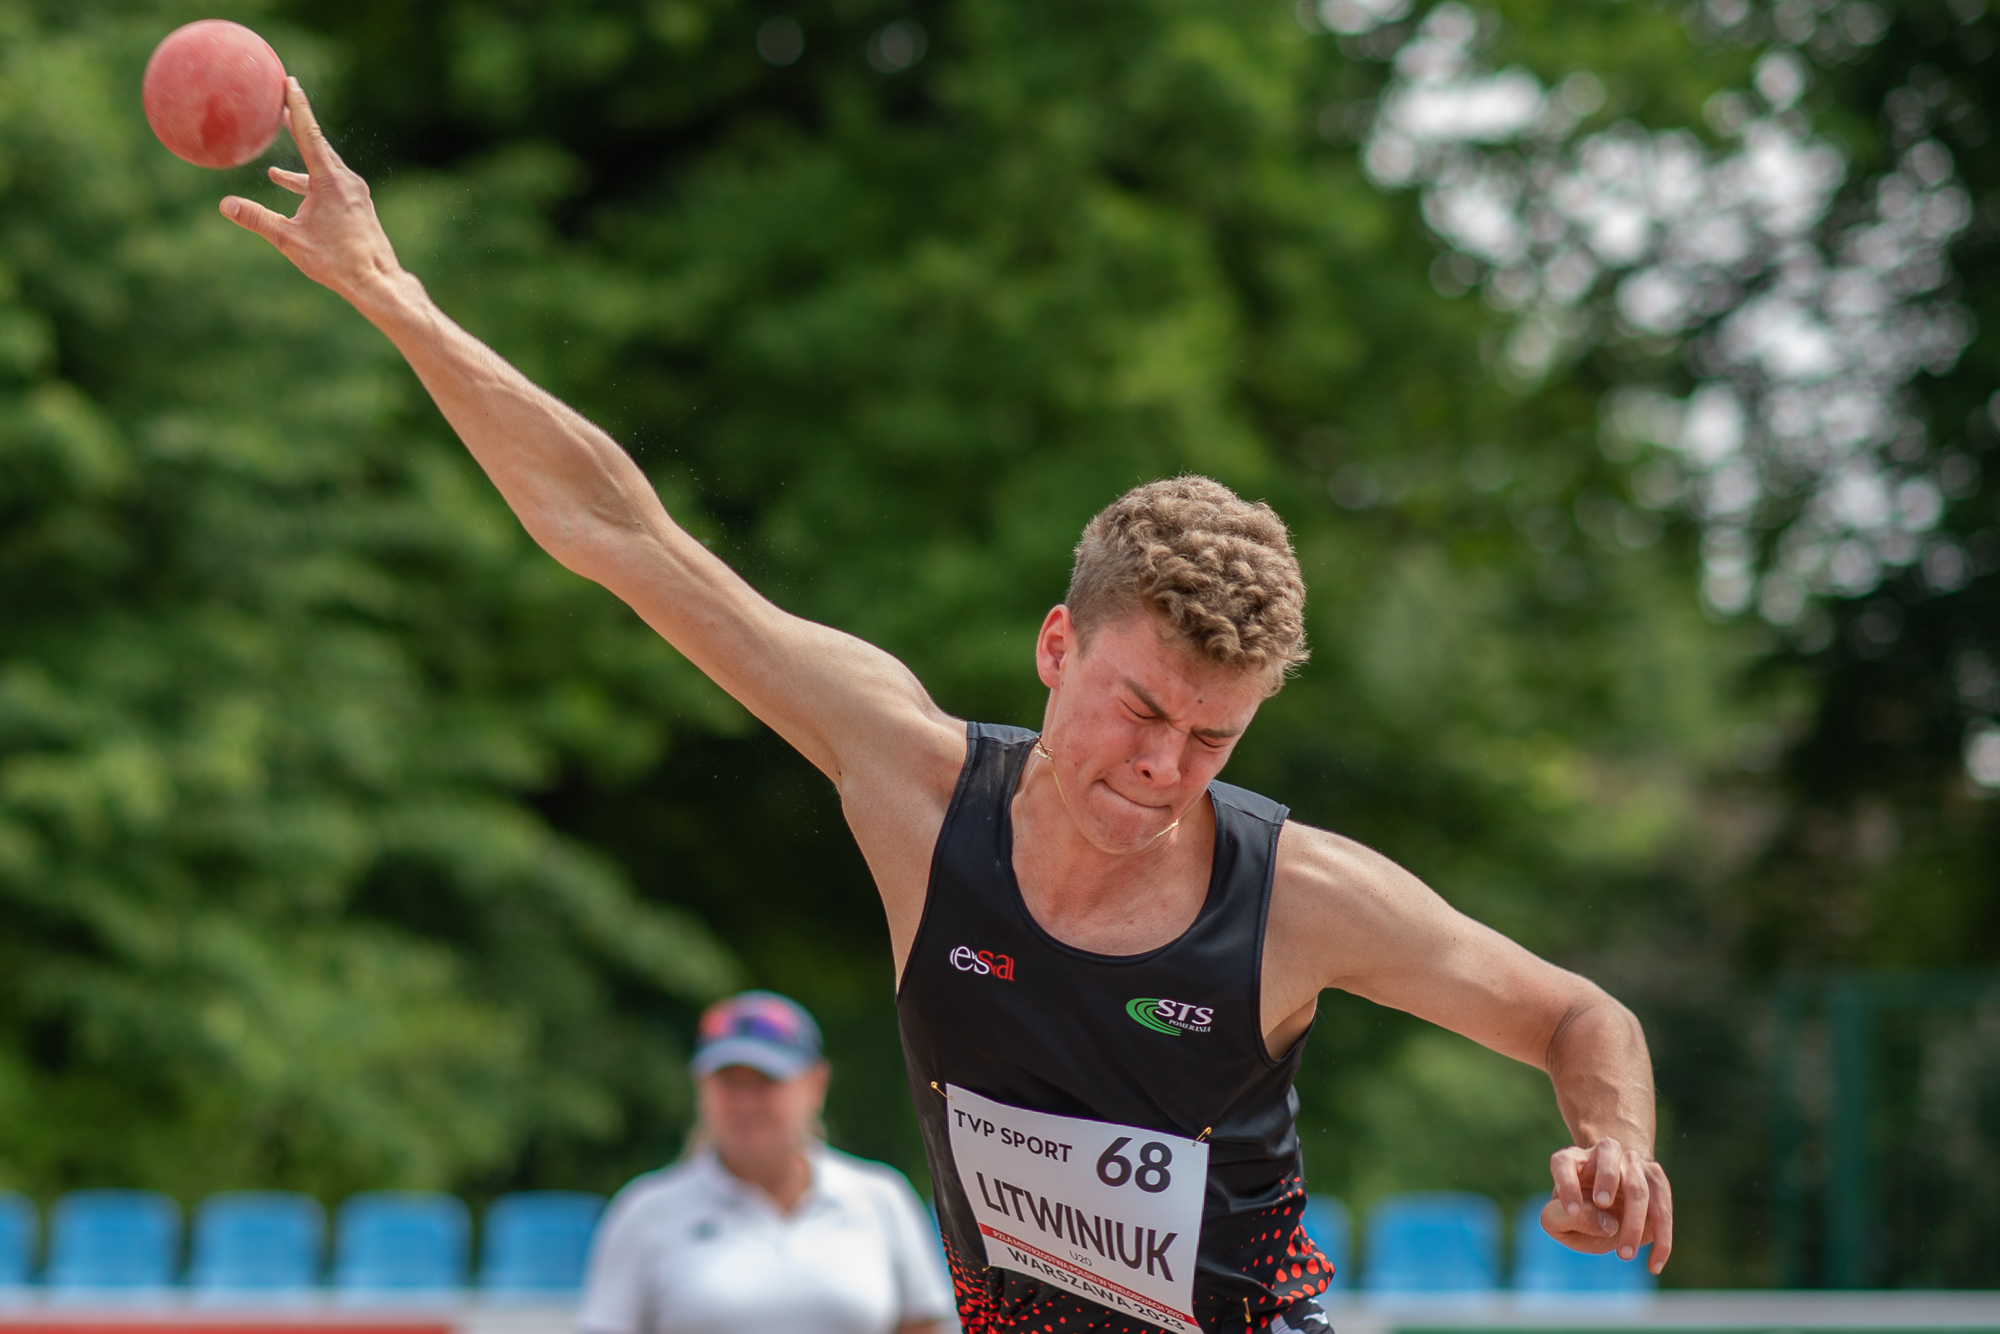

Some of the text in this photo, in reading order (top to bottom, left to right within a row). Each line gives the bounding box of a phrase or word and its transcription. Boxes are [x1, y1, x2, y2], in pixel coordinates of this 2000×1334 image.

[1155, 999, 1214, 1025] STS
[1168, 1019, 1212, 1033] POMERANIA
[953, 1108, 1073, 1163] TVP SPORT
[1096, 1136, 1173, 1193] 68
[976, 1171, 1179, 1283] LITWINIUK
[1069, 1250, 1093, 1267] U20
[1007, 1246, 1186, 1331] WARSZAWA 2023
